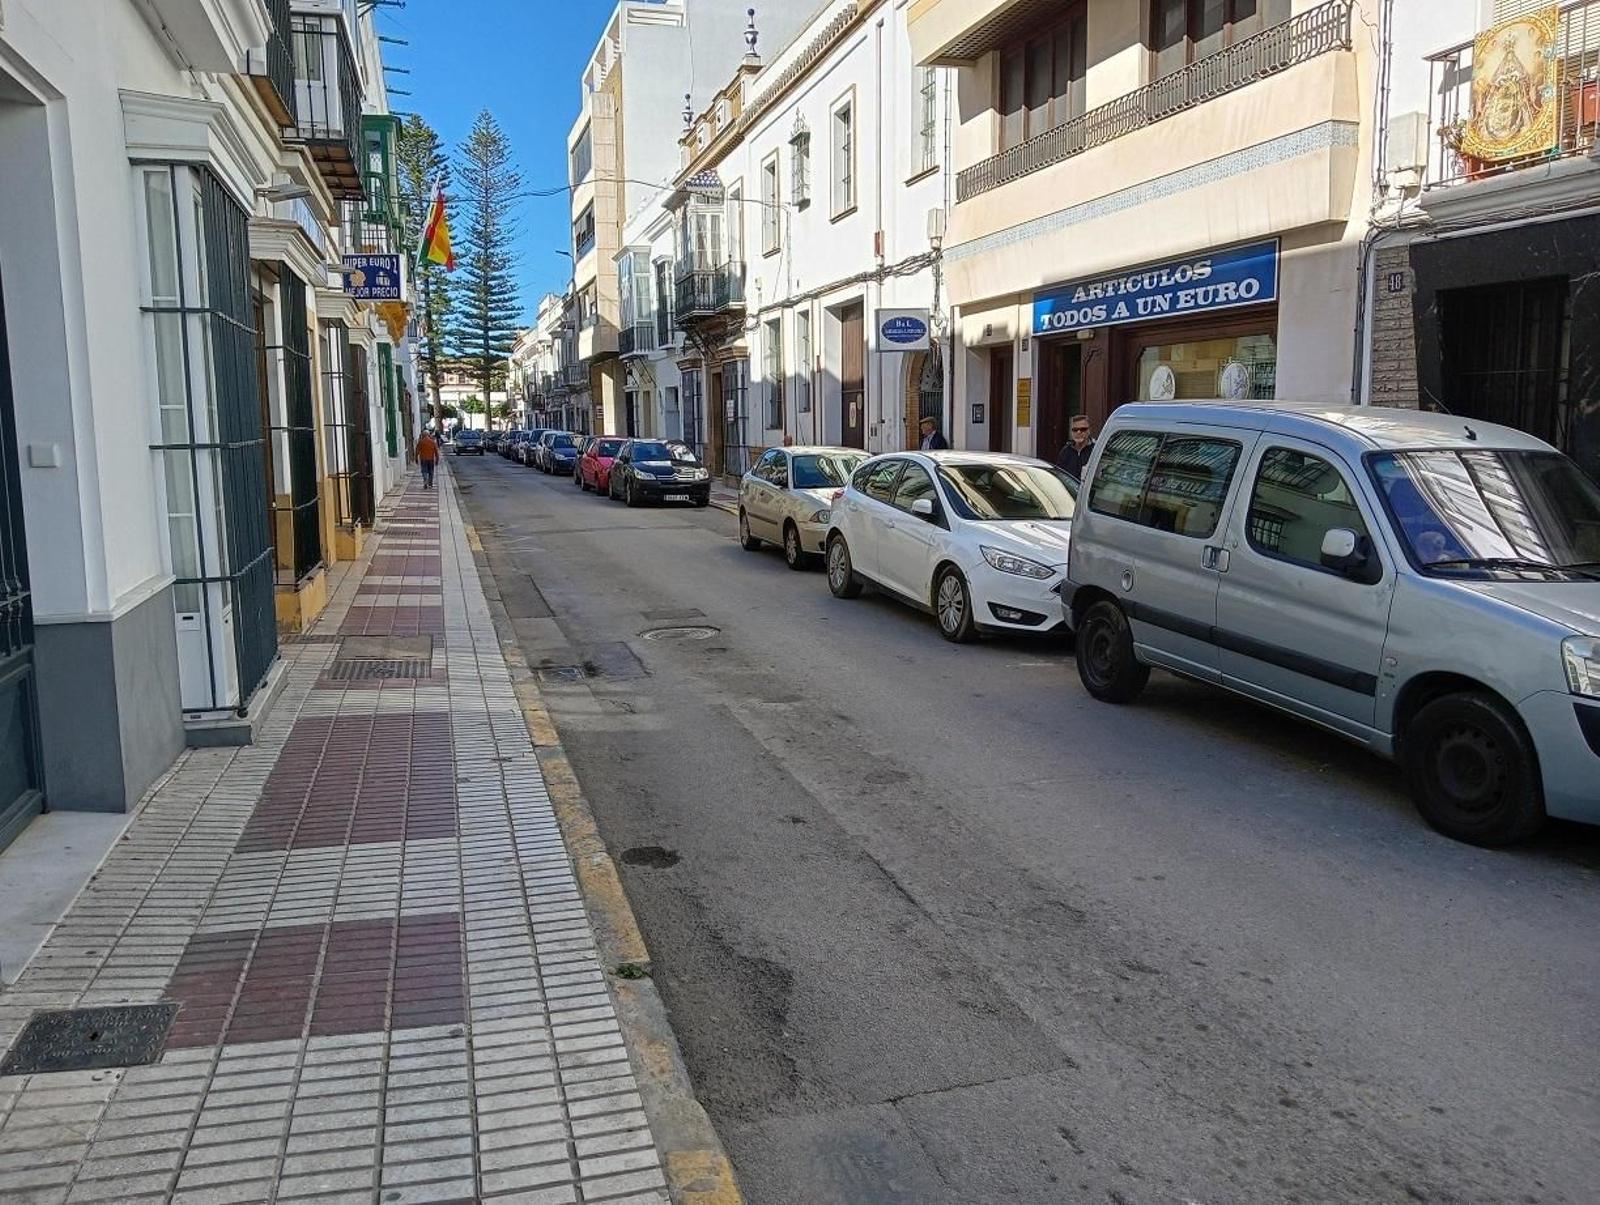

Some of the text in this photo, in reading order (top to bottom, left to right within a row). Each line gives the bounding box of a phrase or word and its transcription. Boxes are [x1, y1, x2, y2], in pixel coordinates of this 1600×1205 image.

[344, 257, 367, 268] HIPER
[369, 257, 390, 270] EURO
[1071, 259, 1213, 304] ARTICULOS
[1388, 274, 1402, 290] 48
[371, 287, 398, 298] PRECIO
[1040, 277, 1260, 330] TODOS A UN EURO
